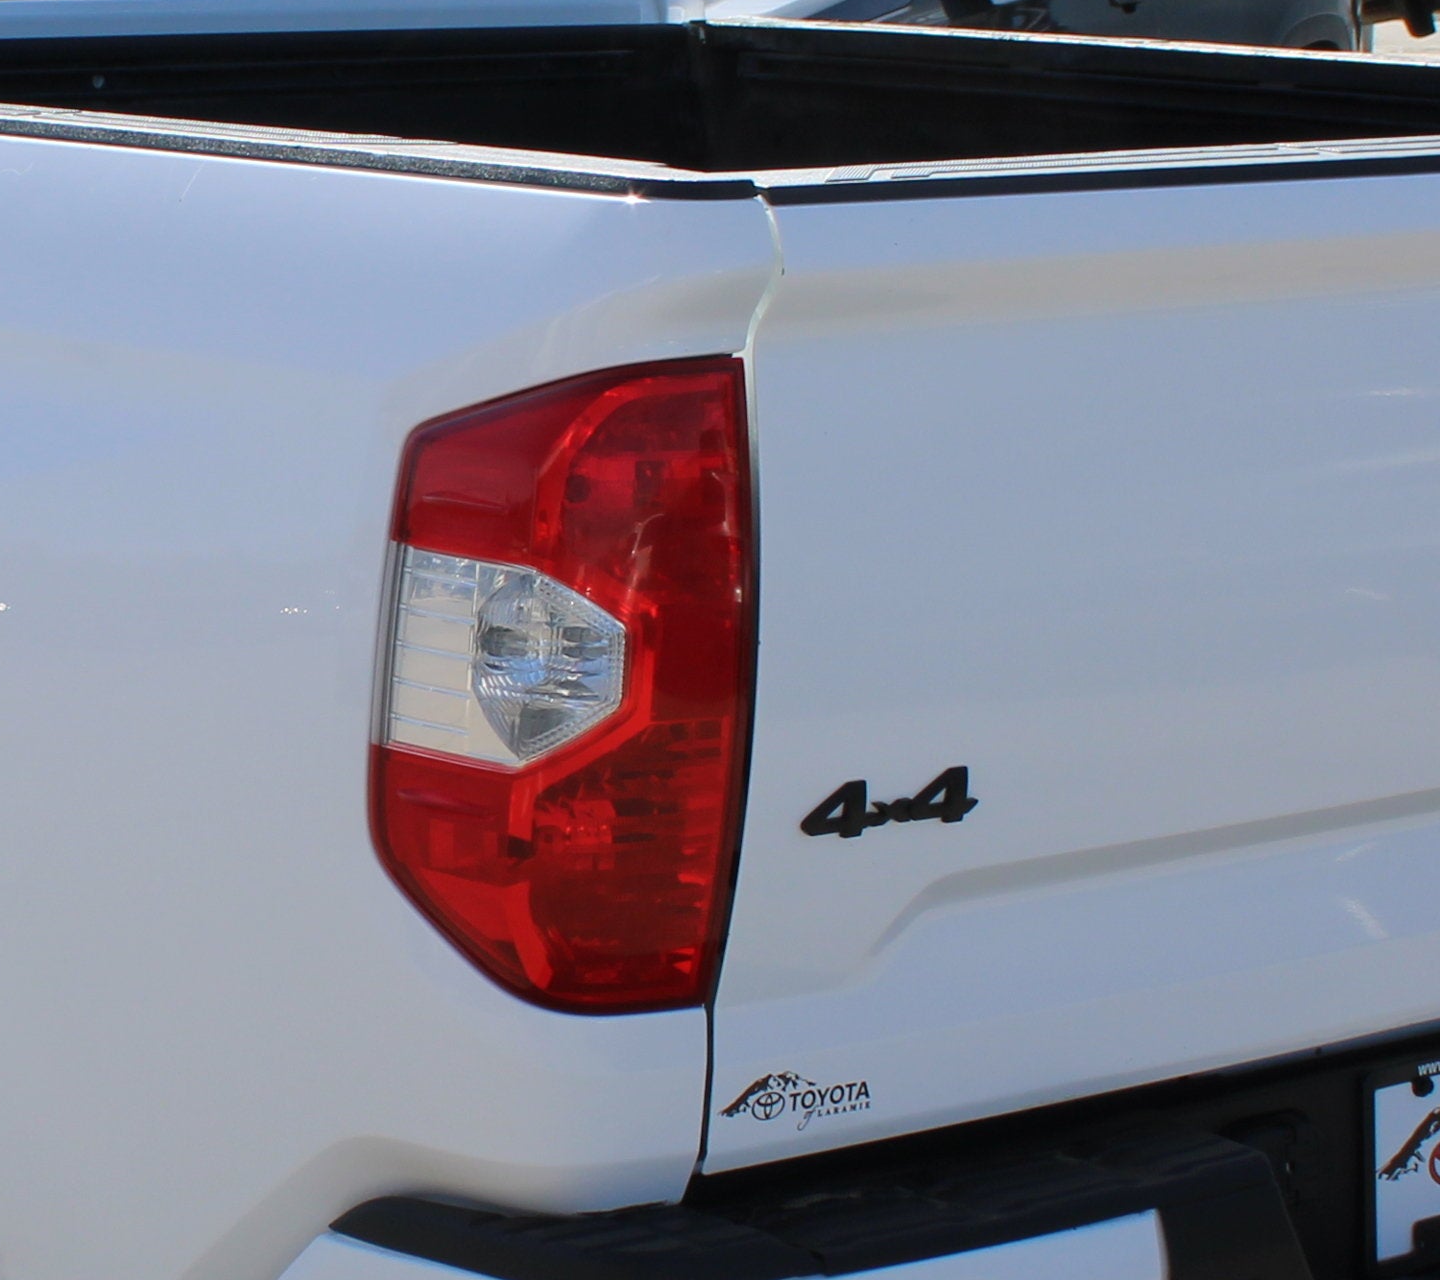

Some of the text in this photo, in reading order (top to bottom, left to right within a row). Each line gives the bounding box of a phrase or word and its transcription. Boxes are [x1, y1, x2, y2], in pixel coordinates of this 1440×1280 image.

[800, 765, 980, 839] 4x4
[789, 1080, 871, 1112] TOYOTA
[817, 1100, 871, 1118] LARAMIE
